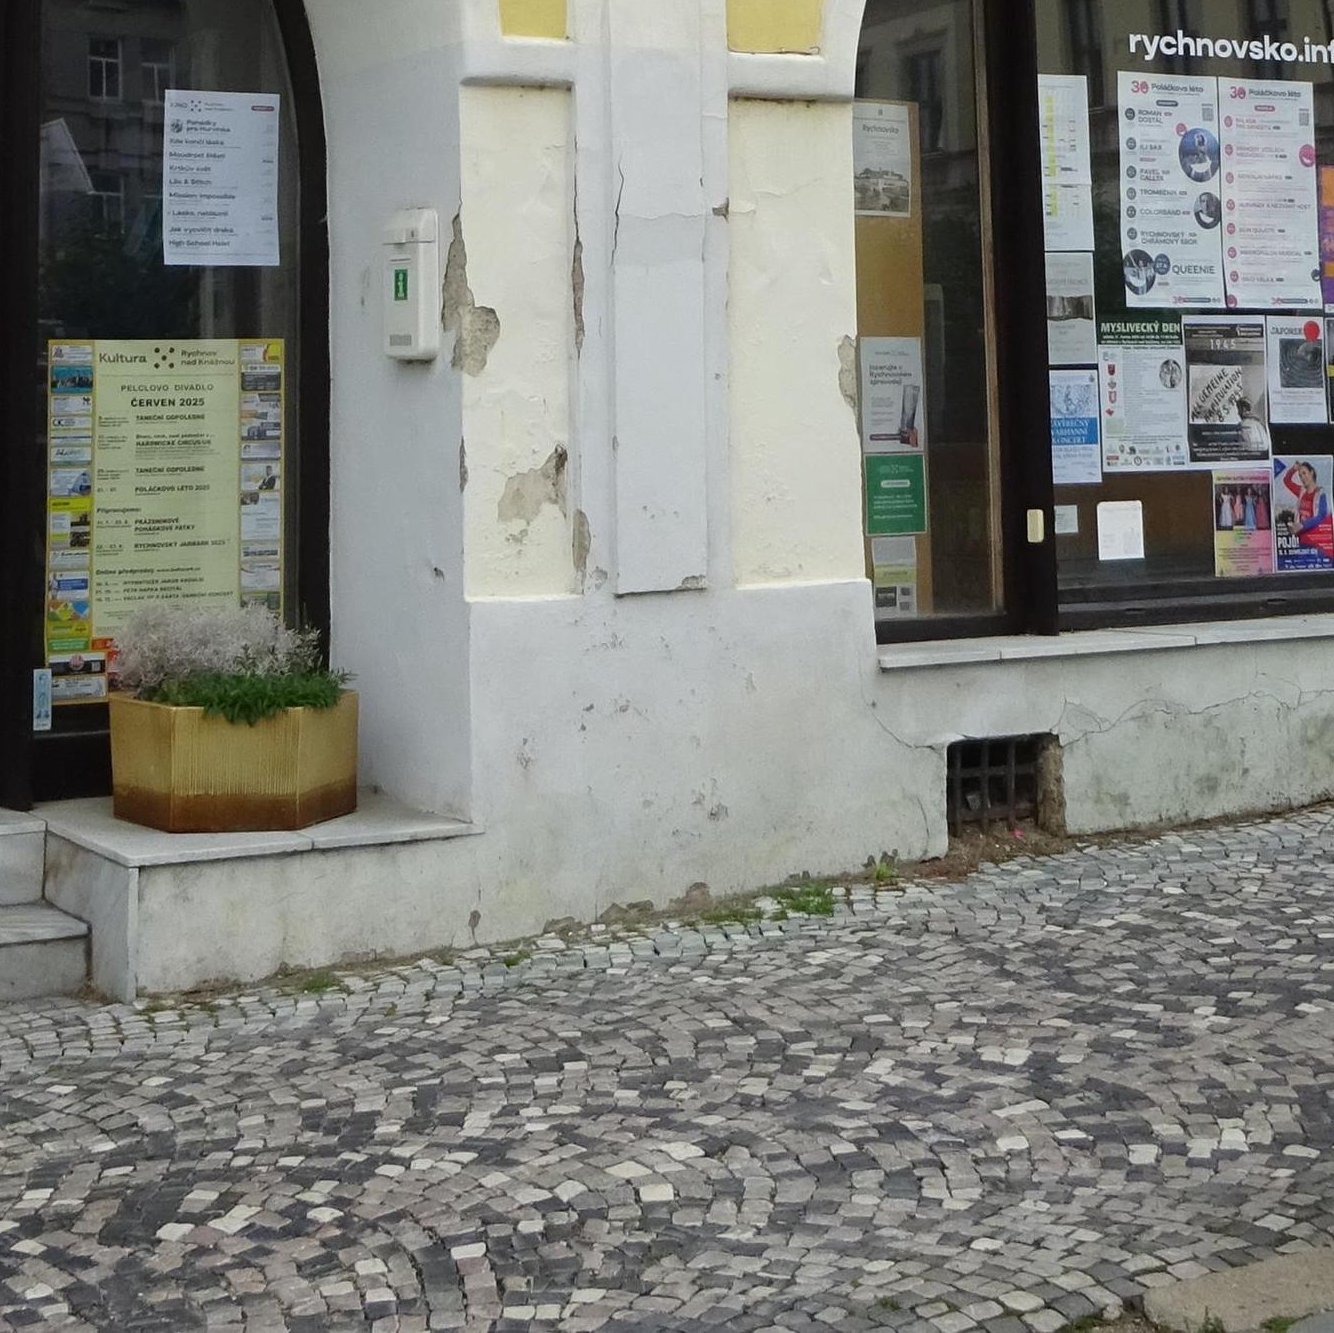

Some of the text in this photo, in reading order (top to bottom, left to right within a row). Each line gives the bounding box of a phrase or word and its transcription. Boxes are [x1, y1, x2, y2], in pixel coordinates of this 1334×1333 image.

[1172, 265, 1216, 275] QUEENIE
[1100, 320, 1160, 333] MYSLIVECKÝ
[1161, 322, 1180, 333] DEN
[99, 352, 147, 364] Kultura
[121, 383, 214, 392] PELCLOVO DIVADLO
[131, 397, 205, 407] ČERVEN 2025
